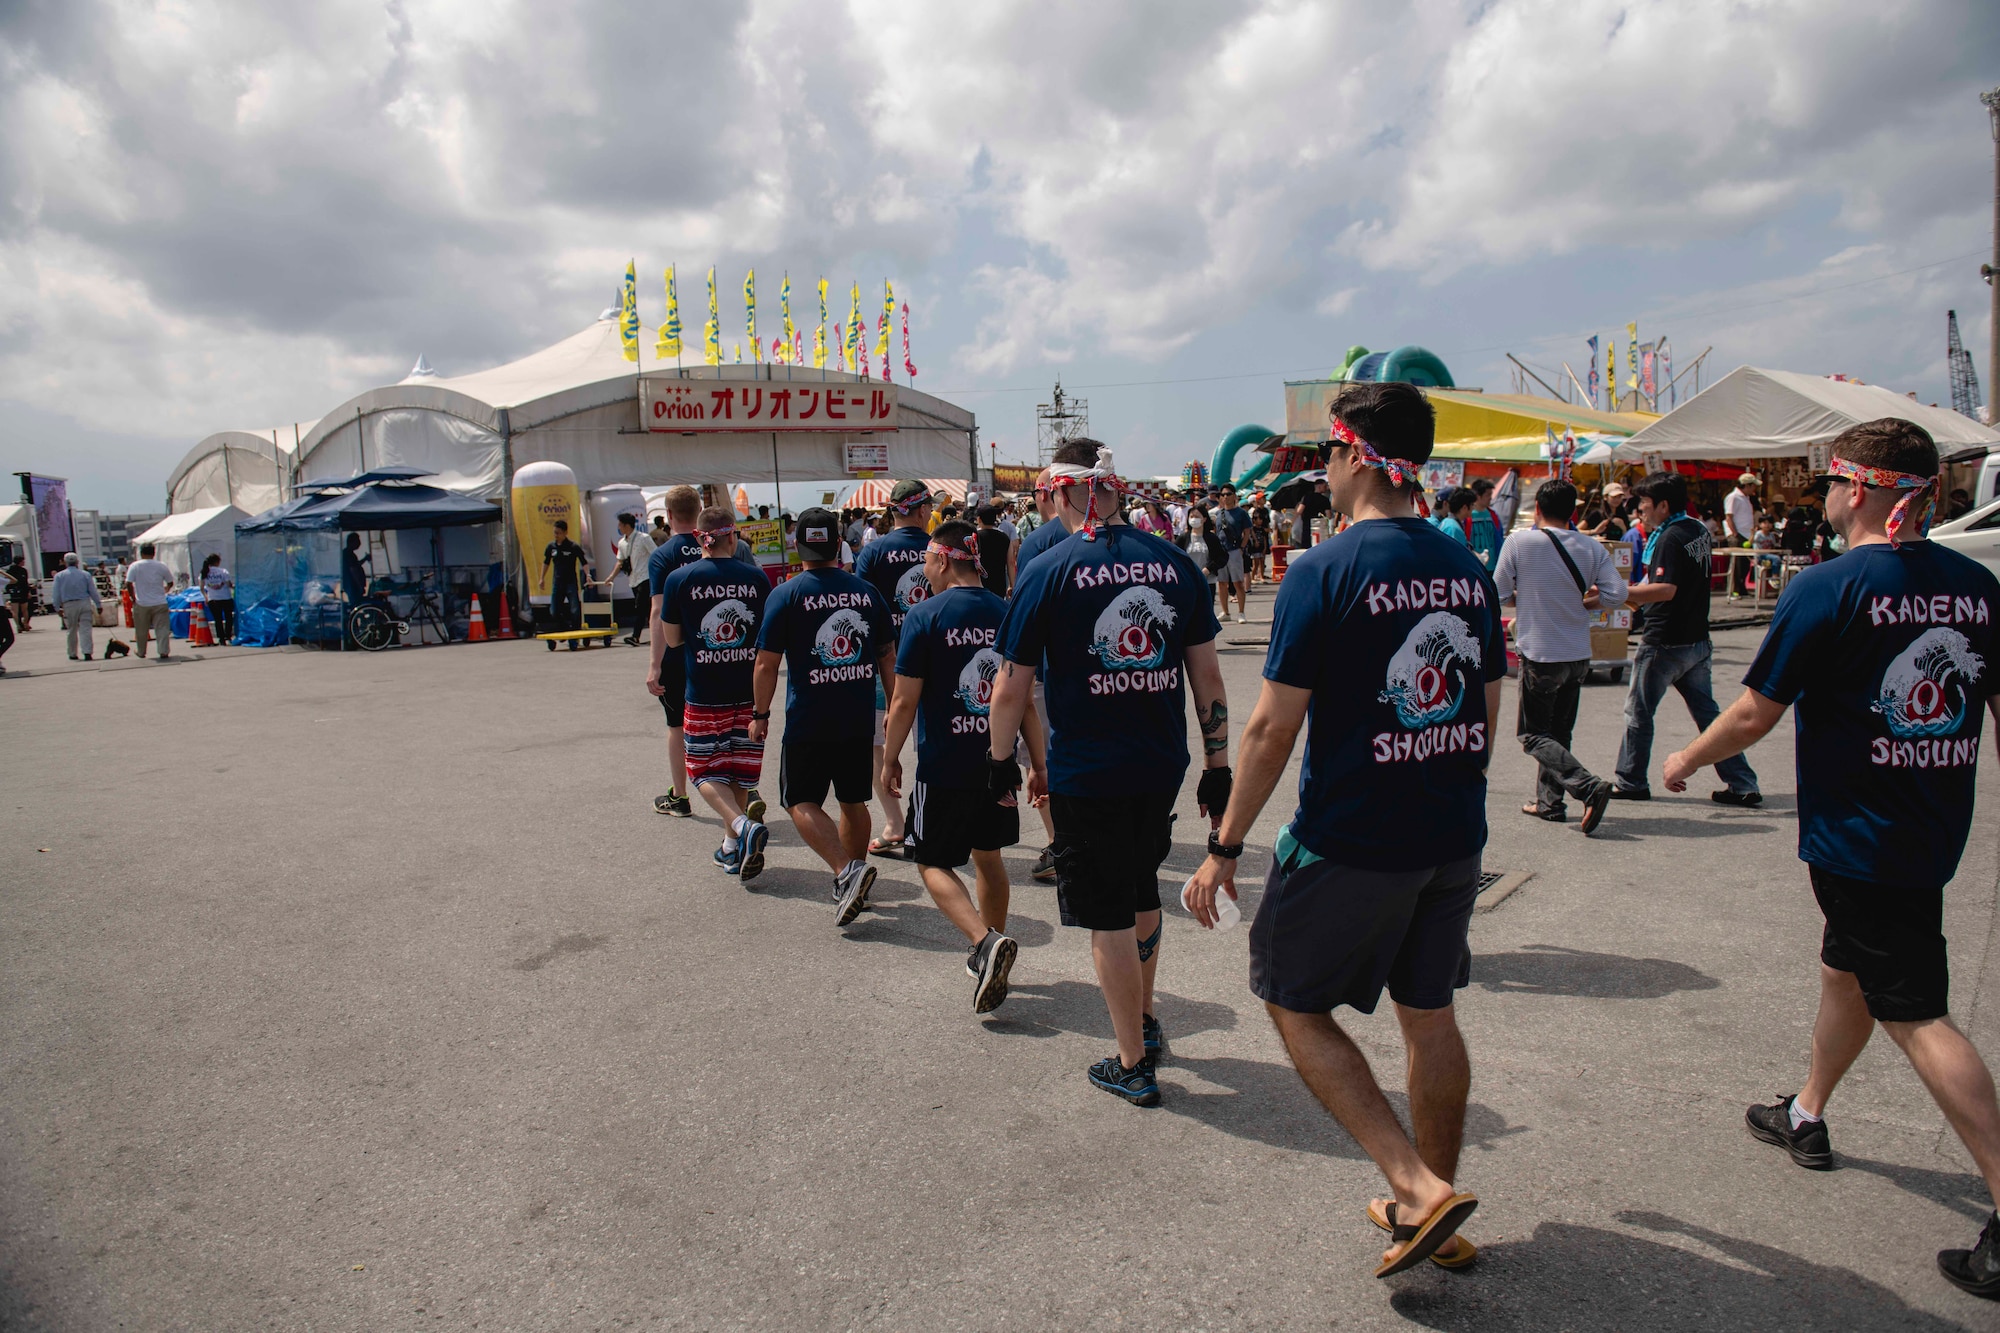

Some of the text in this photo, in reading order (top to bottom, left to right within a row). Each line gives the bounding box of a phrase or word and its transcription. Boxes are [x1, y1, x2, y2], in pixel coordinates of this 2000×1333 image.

[711, 388, 891, 420] オリオンビール
[681, 545, 703, 556] Coa
[887, 550, 928, 564] KADE
[1073, 562, 1178, 590] KADENA
[690, 584, 758, 601] KADENA
[803, 592, 873, 612] KADENA
[1365, 577, 1487, 616] KADENA
[1867, 594, 1989, 627] KADENA
[945, 627, 995, 647] KADE
[696, 647, 757, 664] SHOGUNS
[808, 663, 874, 685] SHOGUNS
[1088, 667, 1178, 695] SHOGUNS
[1373, 722, 1486, 763] SHOGUNS
